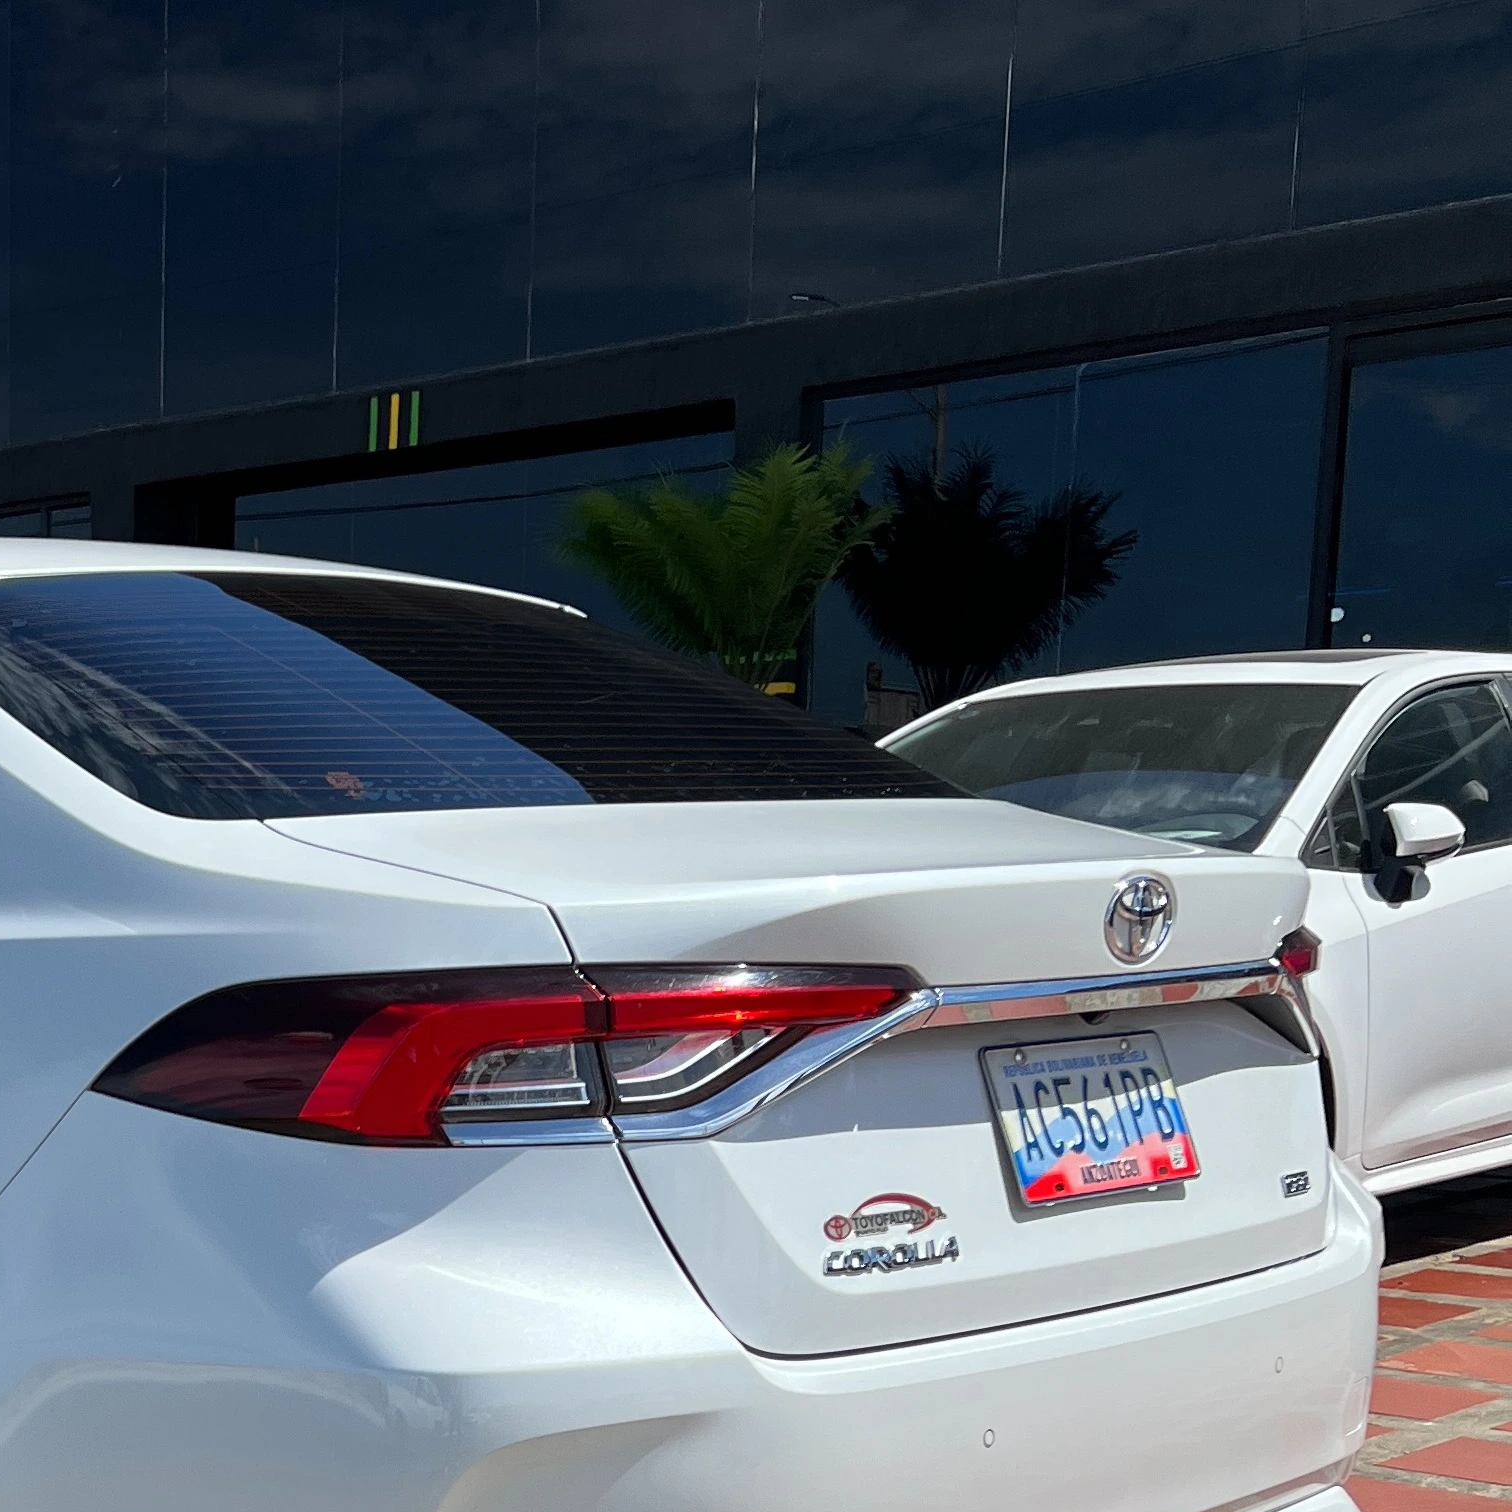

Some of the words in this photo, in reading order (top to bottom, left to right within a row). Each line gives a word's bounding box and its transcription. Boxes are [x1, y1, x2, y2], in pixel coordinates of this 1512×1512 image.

[1012, 1067, 1175, 1162] AC561PB
[852, 1209, 926, 1230] TOYOFALCON
[823, 1236, 960, 1276] COROLLA
